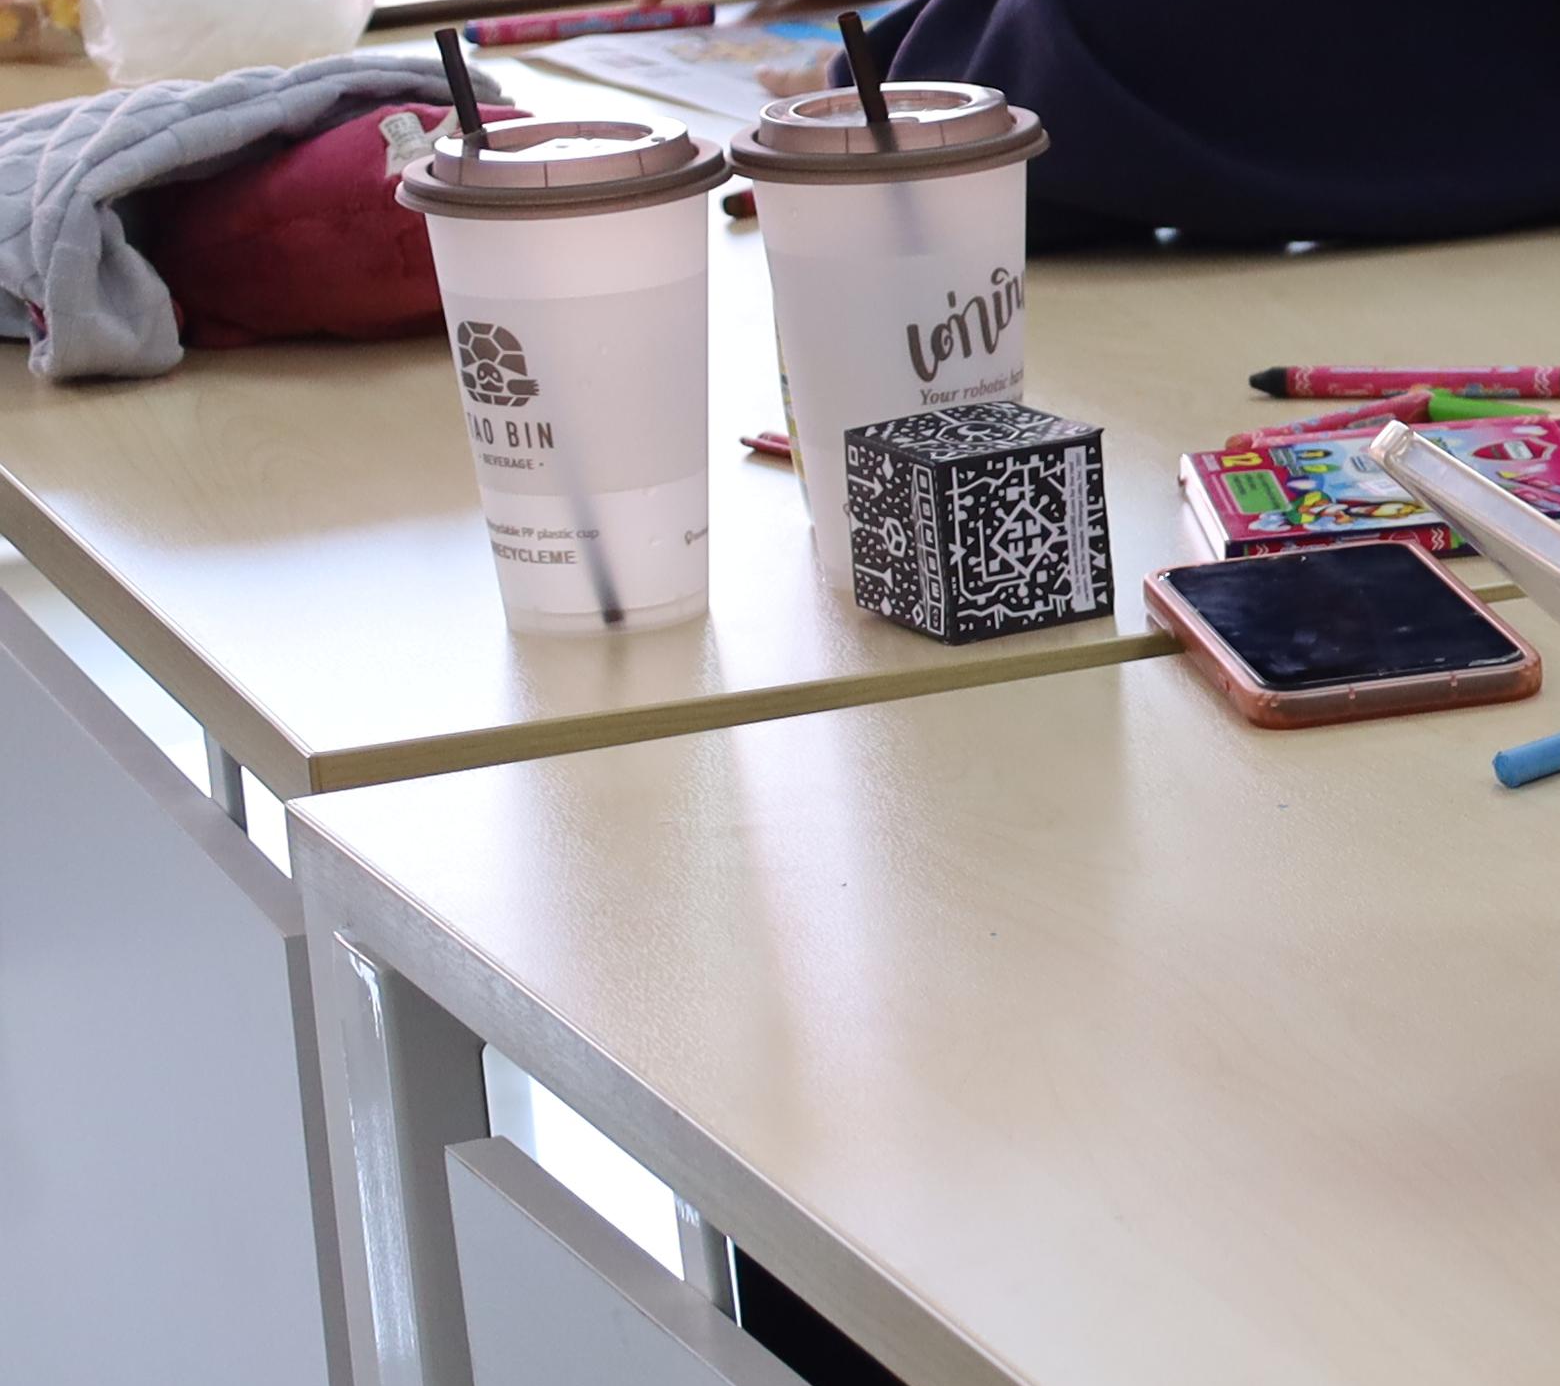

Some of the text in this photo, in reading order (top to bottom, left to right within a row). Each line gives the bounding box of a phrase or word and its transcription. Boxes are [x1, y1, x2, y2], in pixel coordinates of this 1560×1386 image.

[920, 388, 960, 406] Your
[504, 420, 555, 449] BIN
[482, 453, 536, 470] BEVERAGE
[537, 527, 574, 541] plastic
[576, 527, 600, 541] cup
